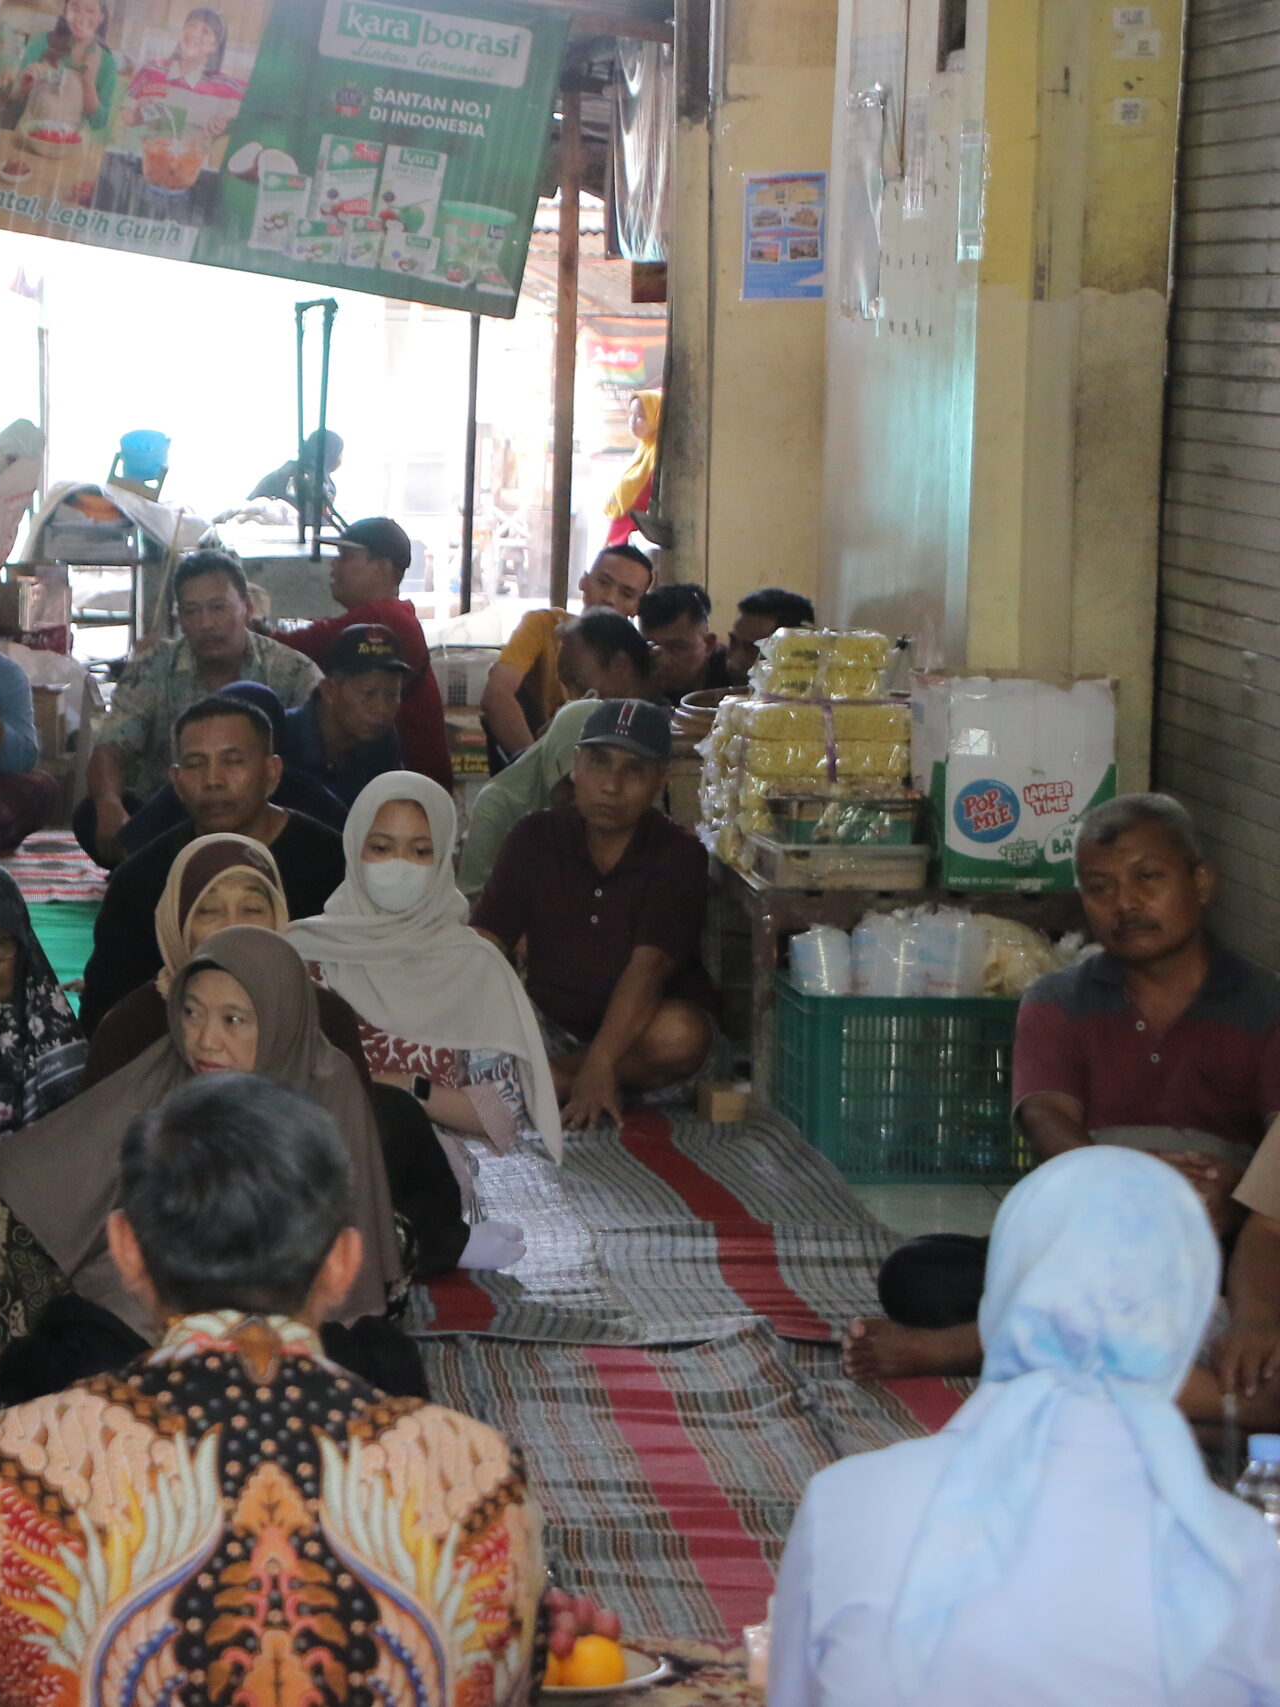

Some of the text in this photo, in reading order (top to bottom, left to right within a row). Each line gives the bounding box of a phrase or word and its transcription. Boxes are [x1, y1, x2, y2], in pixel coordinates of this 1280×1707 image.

[346, 4, 520, 58] kara borasi
[373, 87, 492, 119] SANTAN NO.1
[370, 107, 486, 138] DI INDONESIA
[48, 202, 109, 234] Lebih
[115, 218, 182, 242] Gurih
[962, 789, 1000, 818] POP
[1023, 781, 1073, 803] LAPEER
[1030, 797, 1070, 816] TIME
[973, 804, 1013, 832] MIE
[1051, 838, 1073, 855] BA
